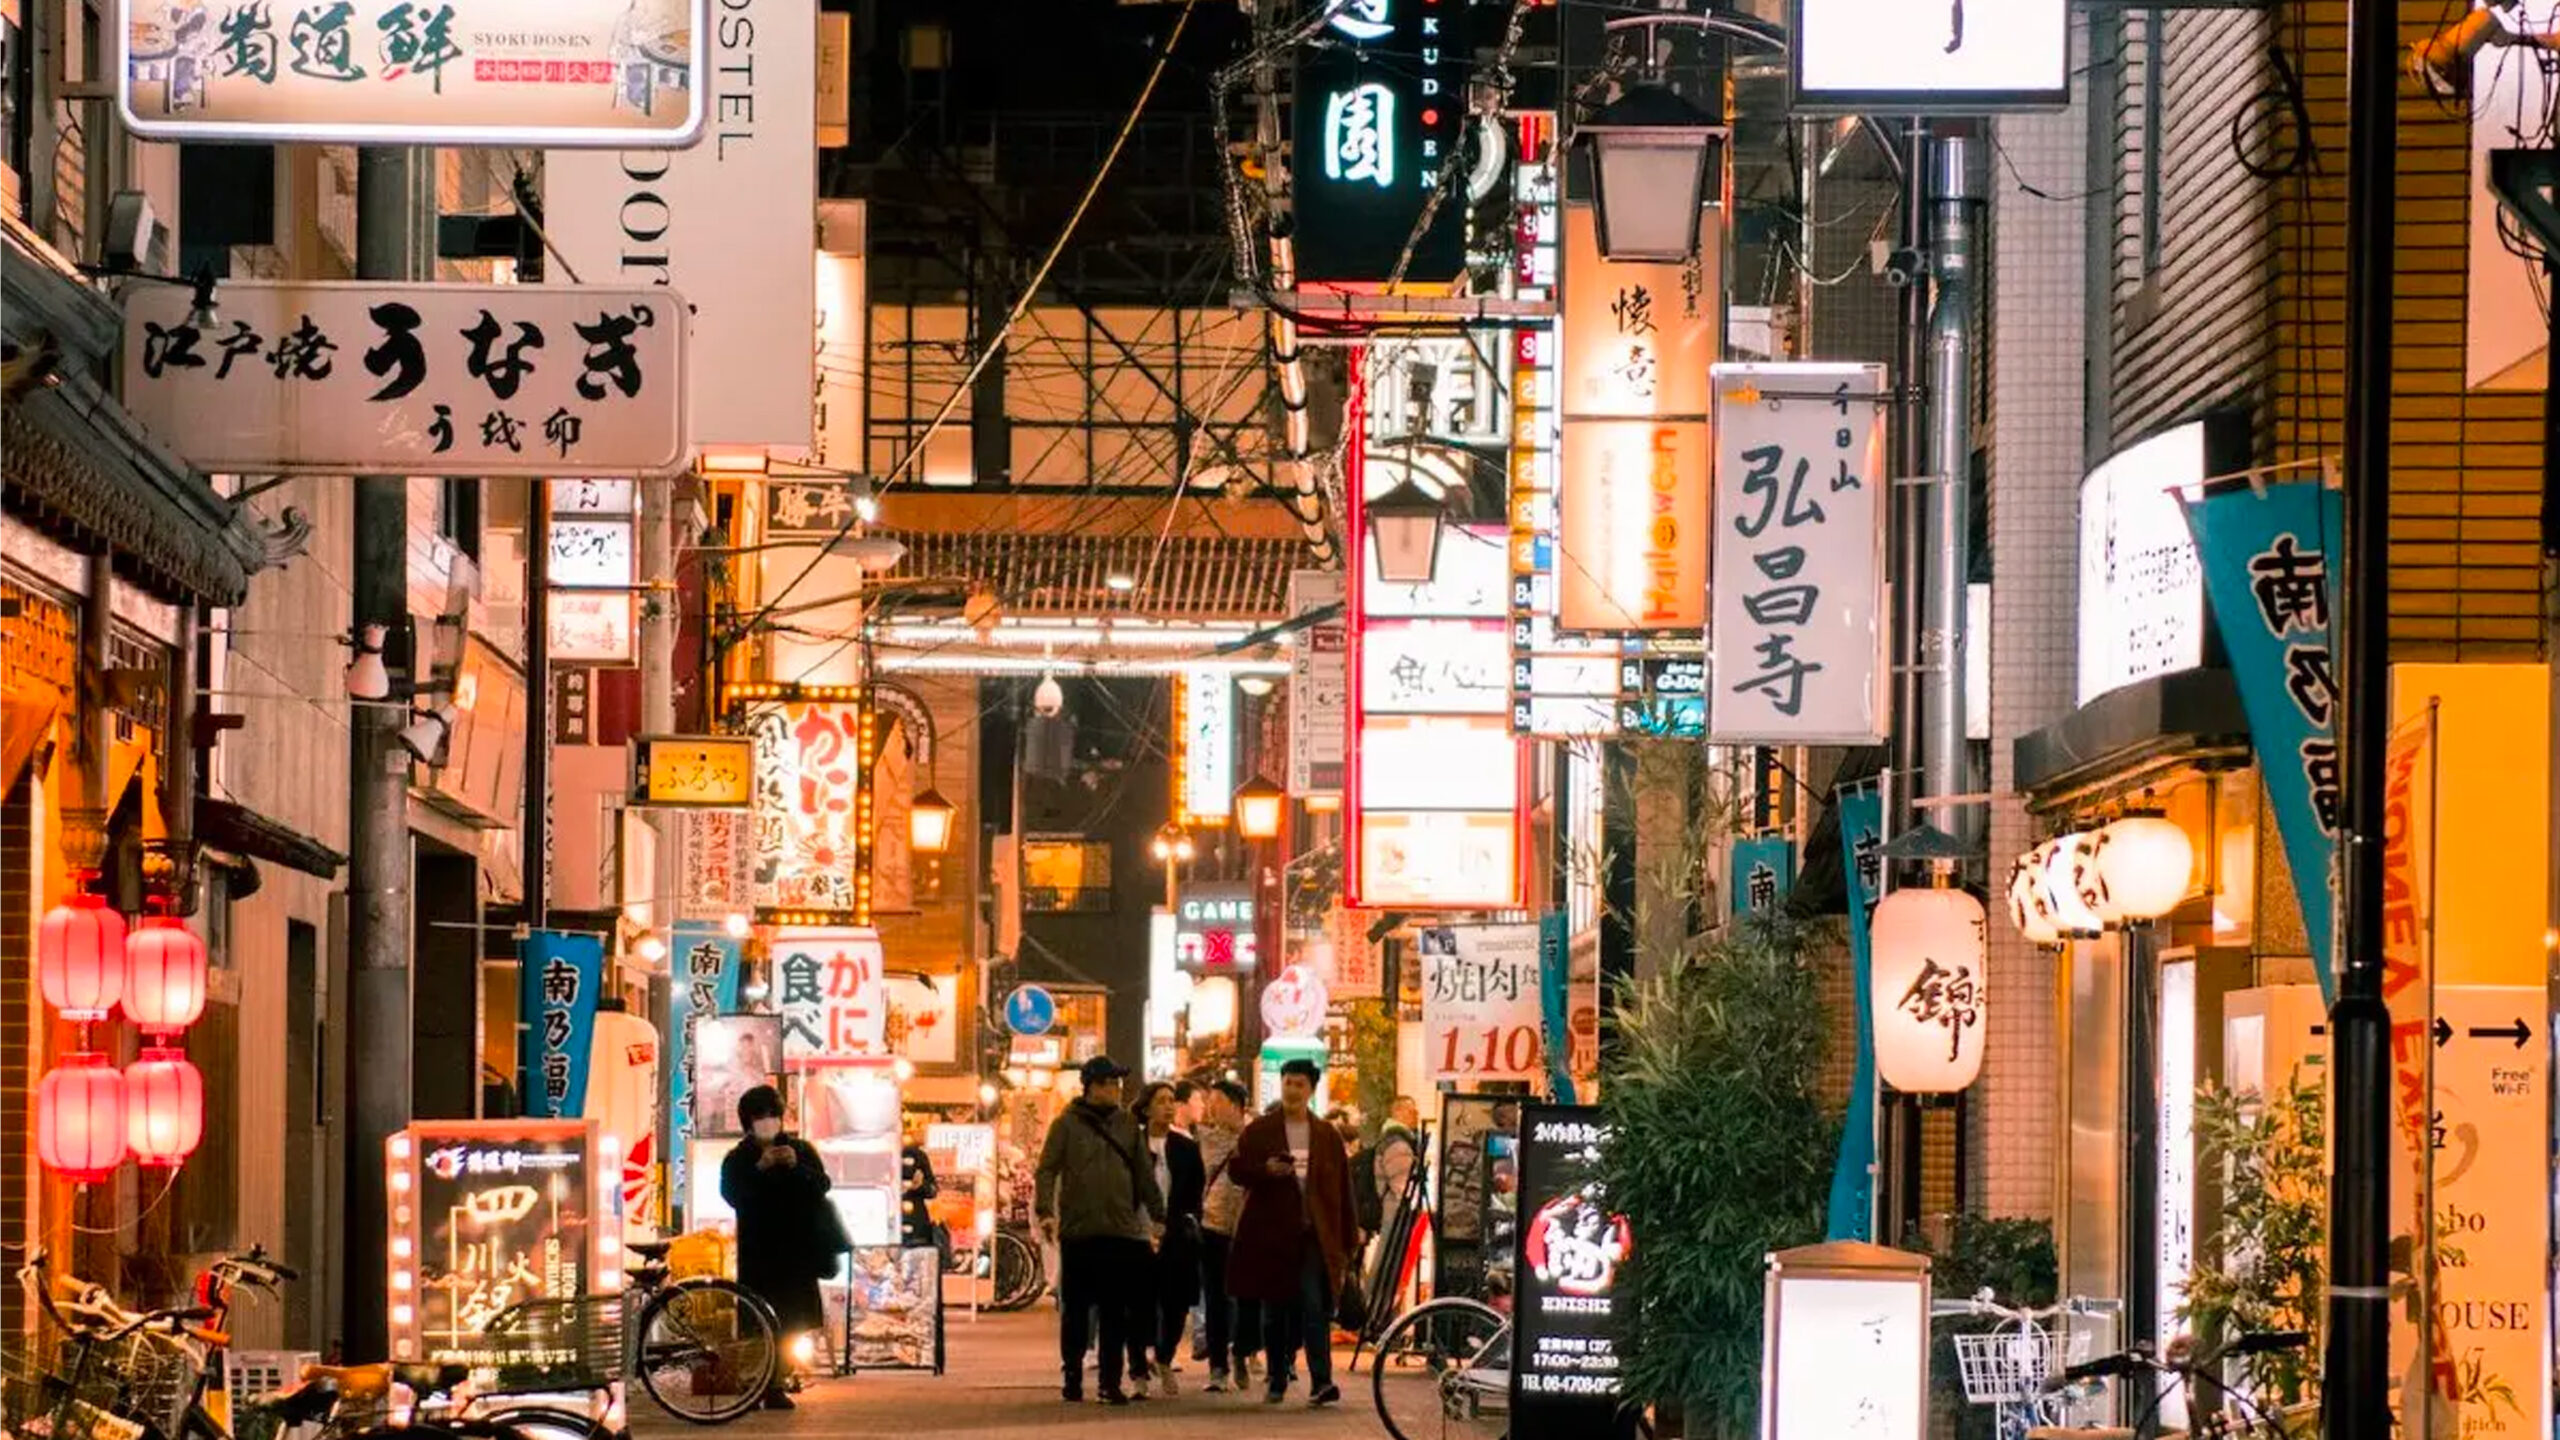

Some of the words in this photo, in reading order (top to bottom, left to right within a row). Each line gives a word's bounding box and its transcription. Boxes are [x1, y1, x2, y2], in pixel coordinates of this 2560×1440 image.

[474, 32, 592, 48] SYOKUDOSEN
[1732, 444, 1826, 716] 弘昌寺
[1184, 900, 1254, 920] GAME
[1898, 957, 1978, 1063] 錦
[2492, 1067, 2530, 1081] Free
[2492, 1082, 2530, 1095] Wi-Fi
